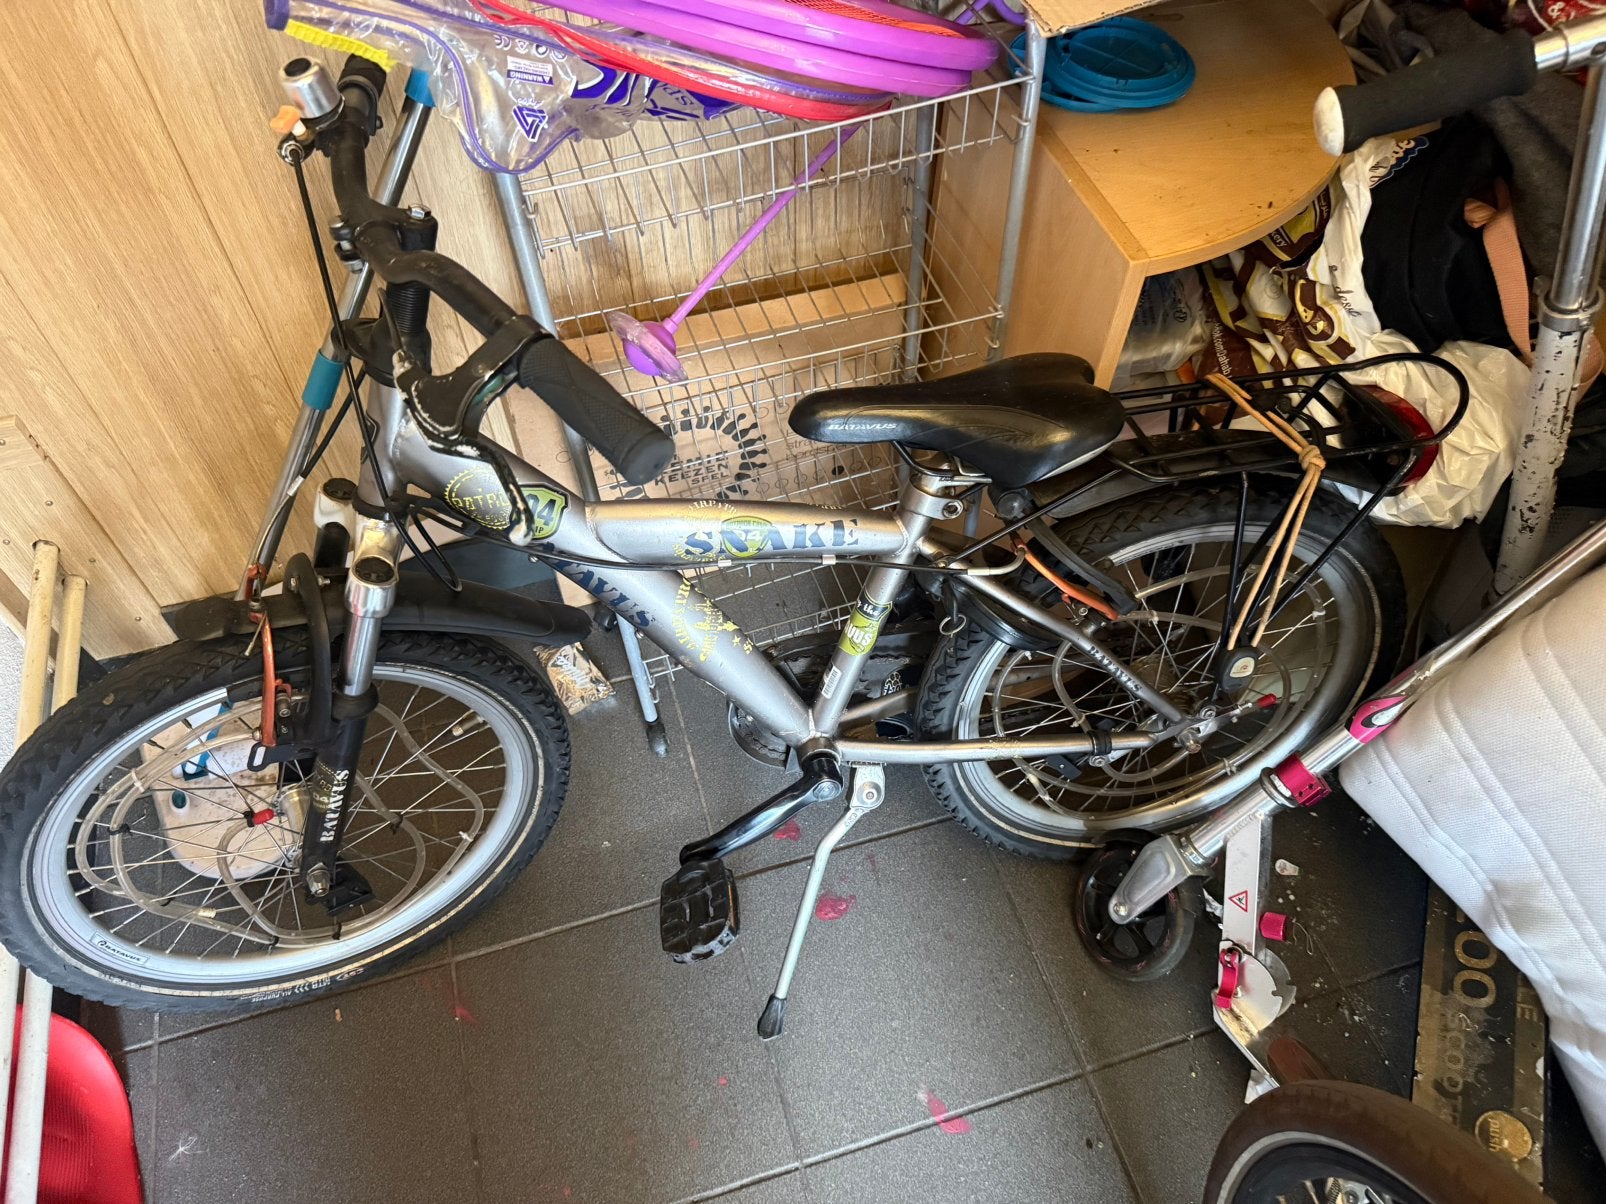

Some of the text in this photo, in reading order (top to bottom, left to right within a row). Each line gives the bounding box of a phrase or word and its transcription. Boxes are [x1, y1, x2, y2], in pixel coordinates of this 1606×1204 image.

[509, 70, 544, 83] WARNING
[828, 422, 898, 431] BATAVUS
[655, 462, 730, 487] KEEZEN
[319, 769, 350, 841] BATAVUS
[105, 945, 141, 962] BATAVUS
[312, 976, 331, 990] MTB
[1488, 1117, 1501, 1152] push
